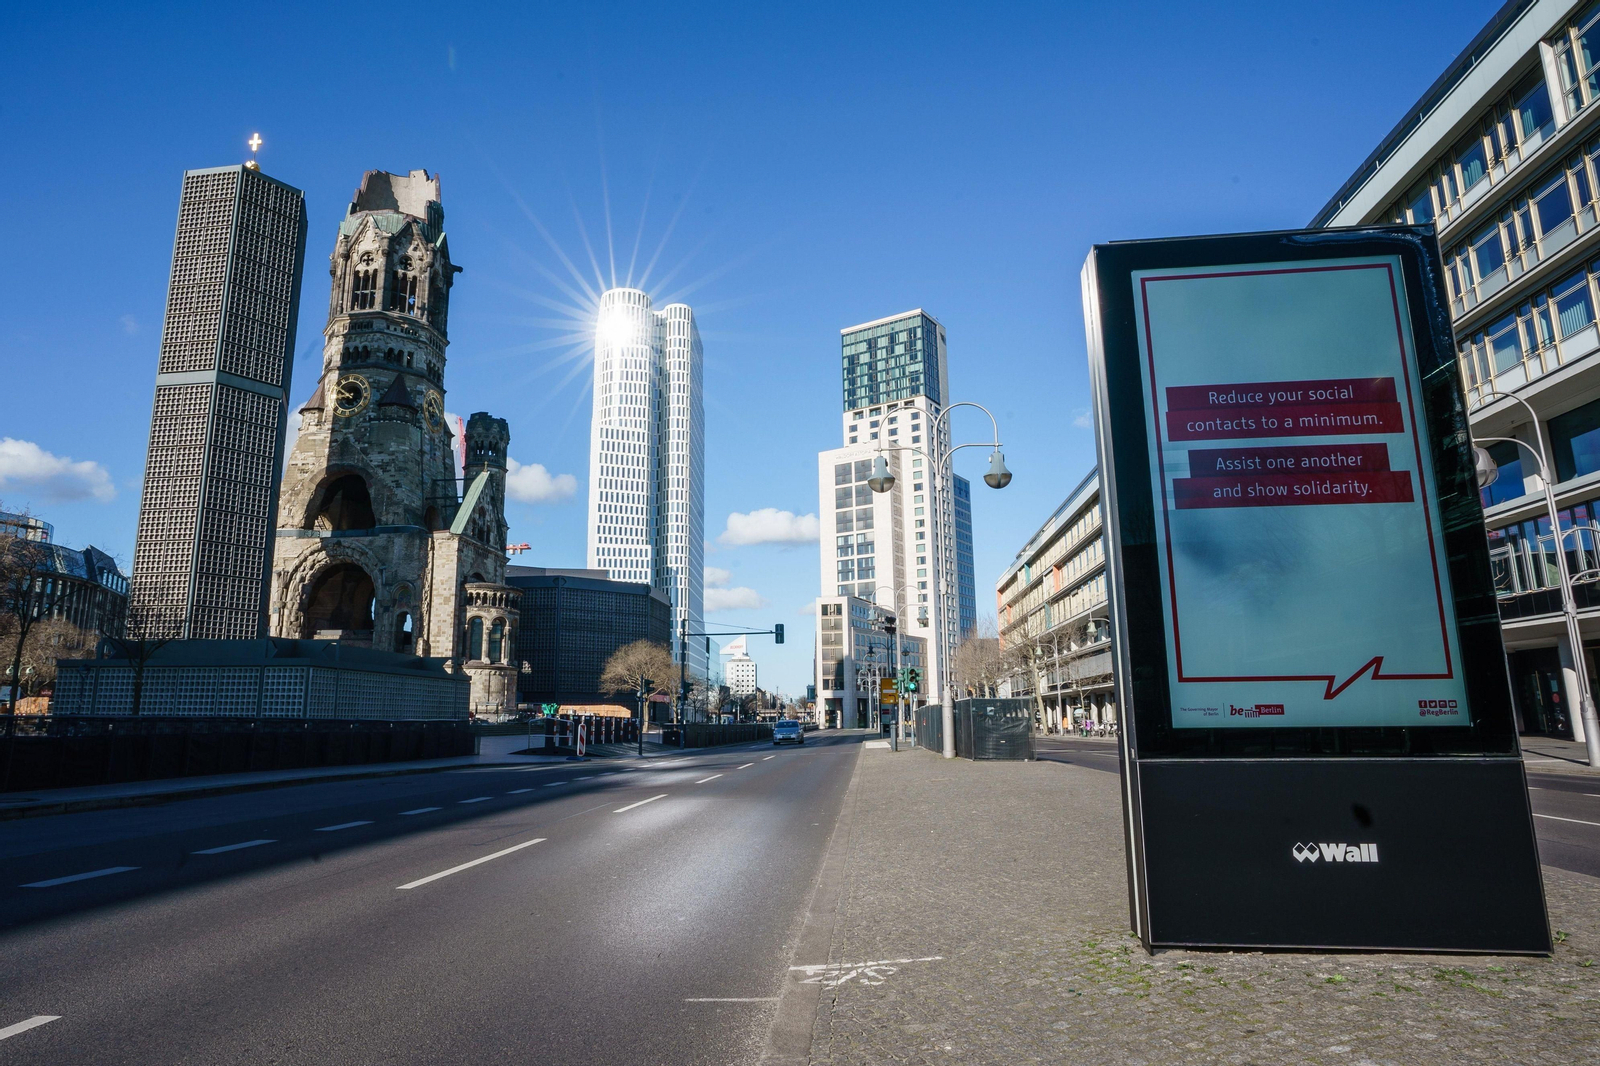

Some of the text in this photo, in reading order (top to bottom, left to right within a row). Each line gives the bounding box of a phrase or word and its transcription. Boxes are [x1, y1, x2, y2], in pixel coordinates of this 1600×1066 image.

[1208, 385, 1354, 406] Reduce your social
[1186, 412, 1383, 432] contacts to a minimum.
[1216, 453, 1363, 471] Assist one another
[1213, 478, 1373, 498] and show solidarity.
[1260, 706, 1282, 714] Berlin
[1419, 709, 1459, 717] @RegBerlin
[1319, 843, 1379, 862] Wall
